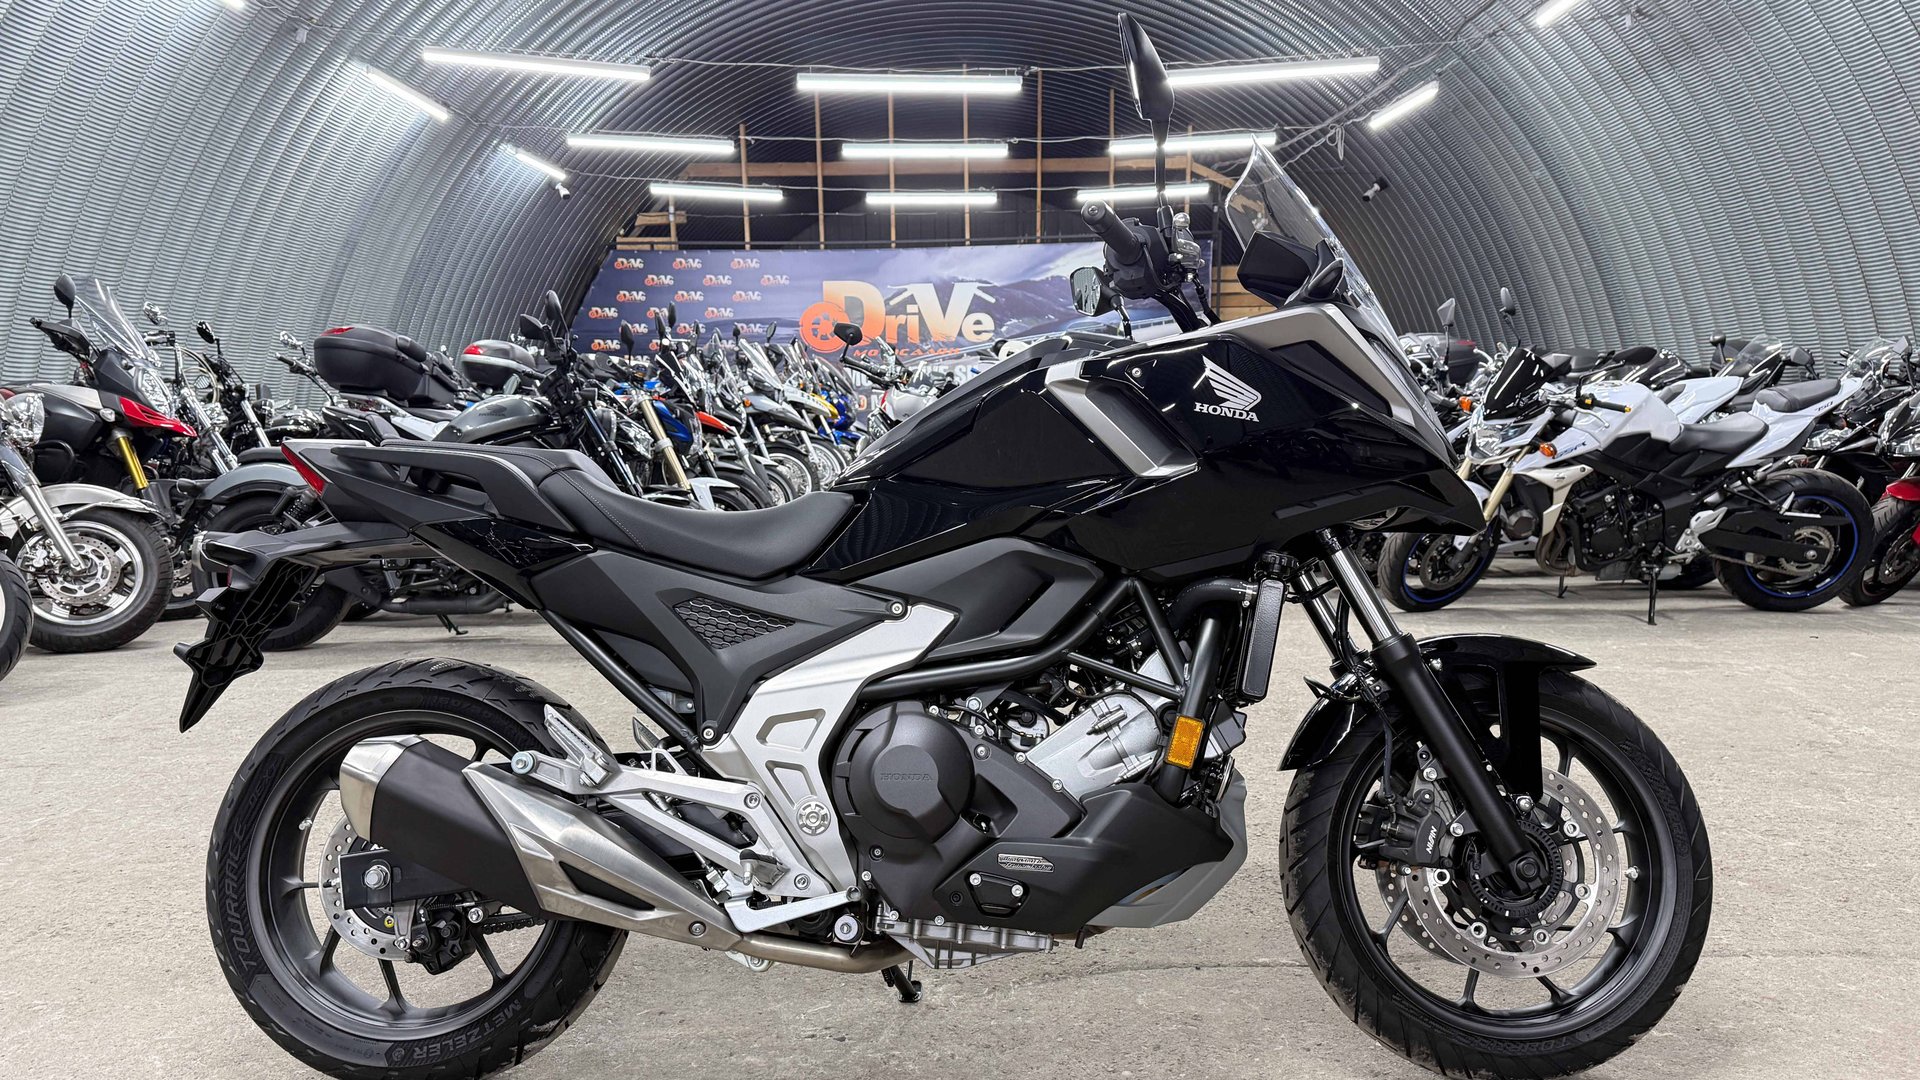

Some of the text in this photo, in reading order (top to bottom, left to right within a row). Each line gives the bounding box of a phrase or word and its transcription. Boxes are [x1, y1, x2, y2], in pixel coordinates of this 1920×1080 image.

[822, 280, 997, 345] DriVe
[1194, 402, 1259, 422] HONDA
[880, 772, 932, 781] HONDA
[225, 817, 257, 972] TOURANCE
[412, 999, 522, 1059] METZELER
